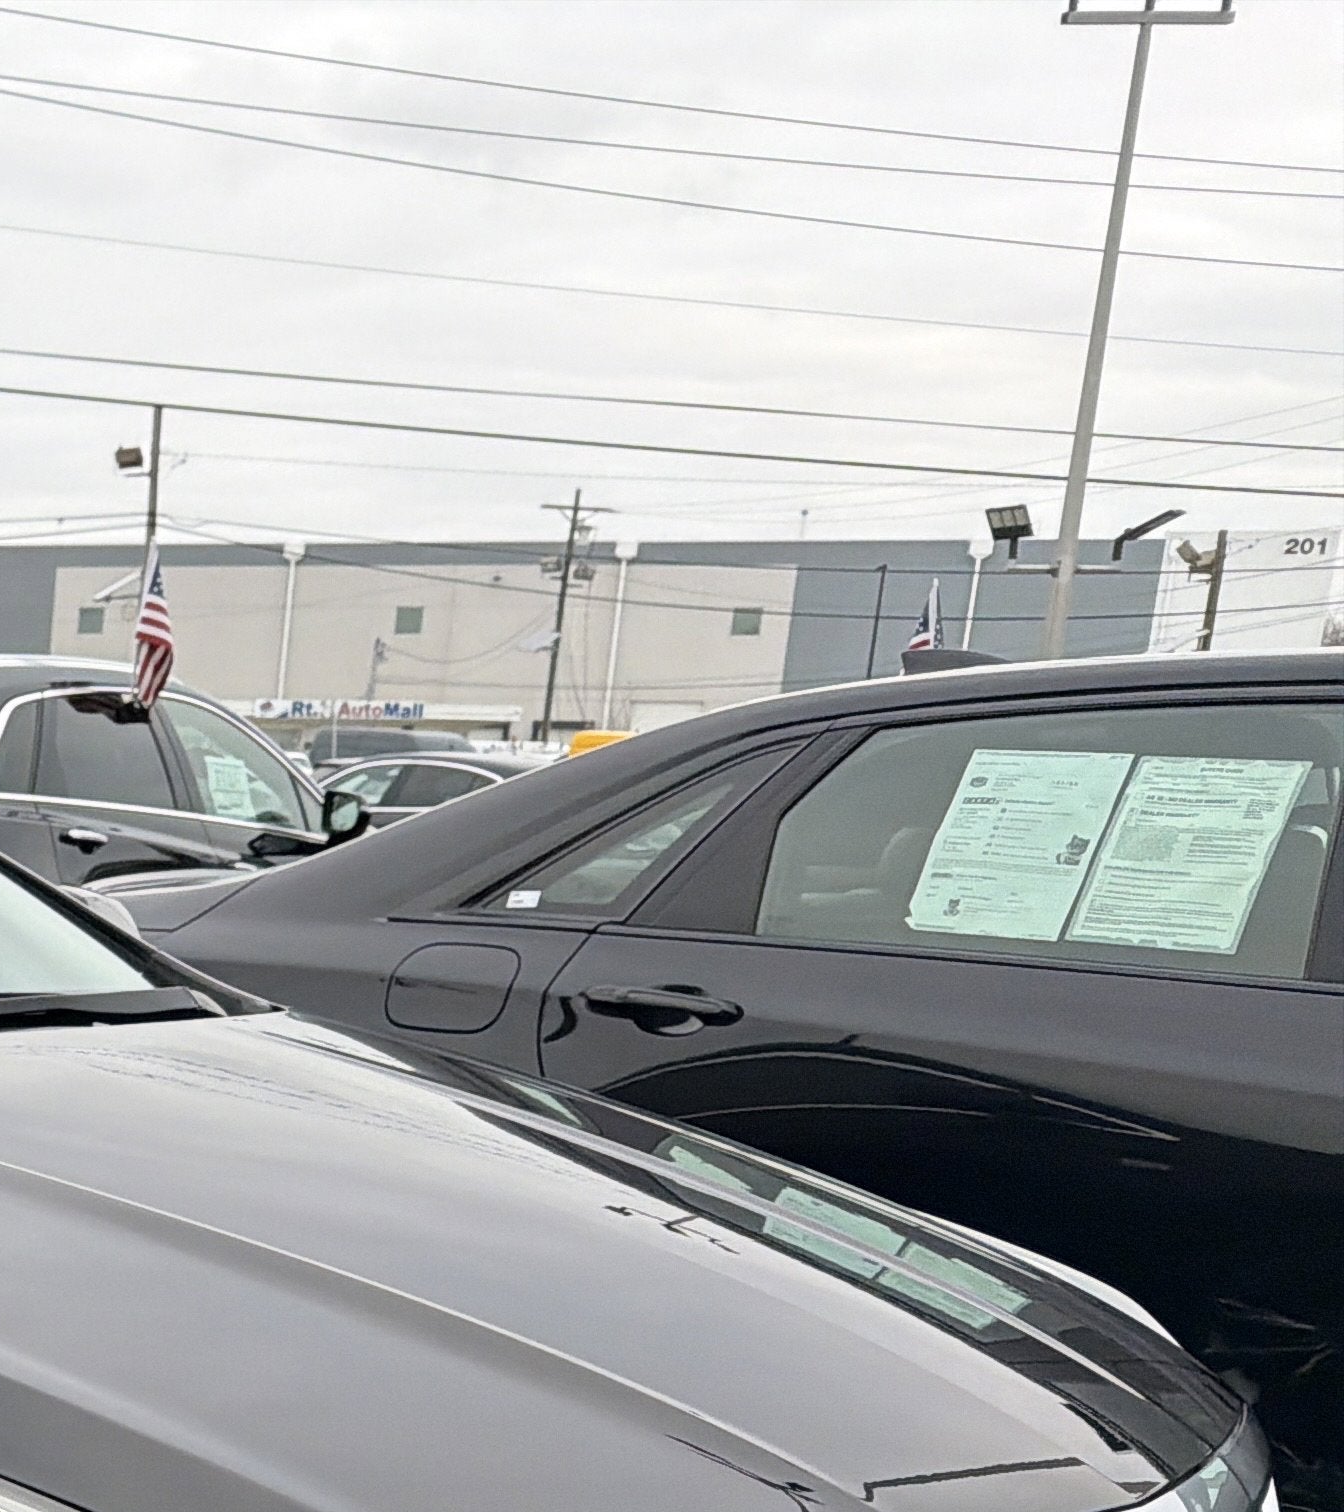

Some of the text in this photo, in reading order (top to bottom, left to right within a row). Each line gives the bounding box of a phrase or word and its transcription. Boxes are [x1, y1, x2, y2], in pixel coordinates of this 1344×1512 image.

[1284, 537, 1328, 555] 201
[291, 701, 318, 717] Rt.
[338, 702, 425, 719] AutoMall
